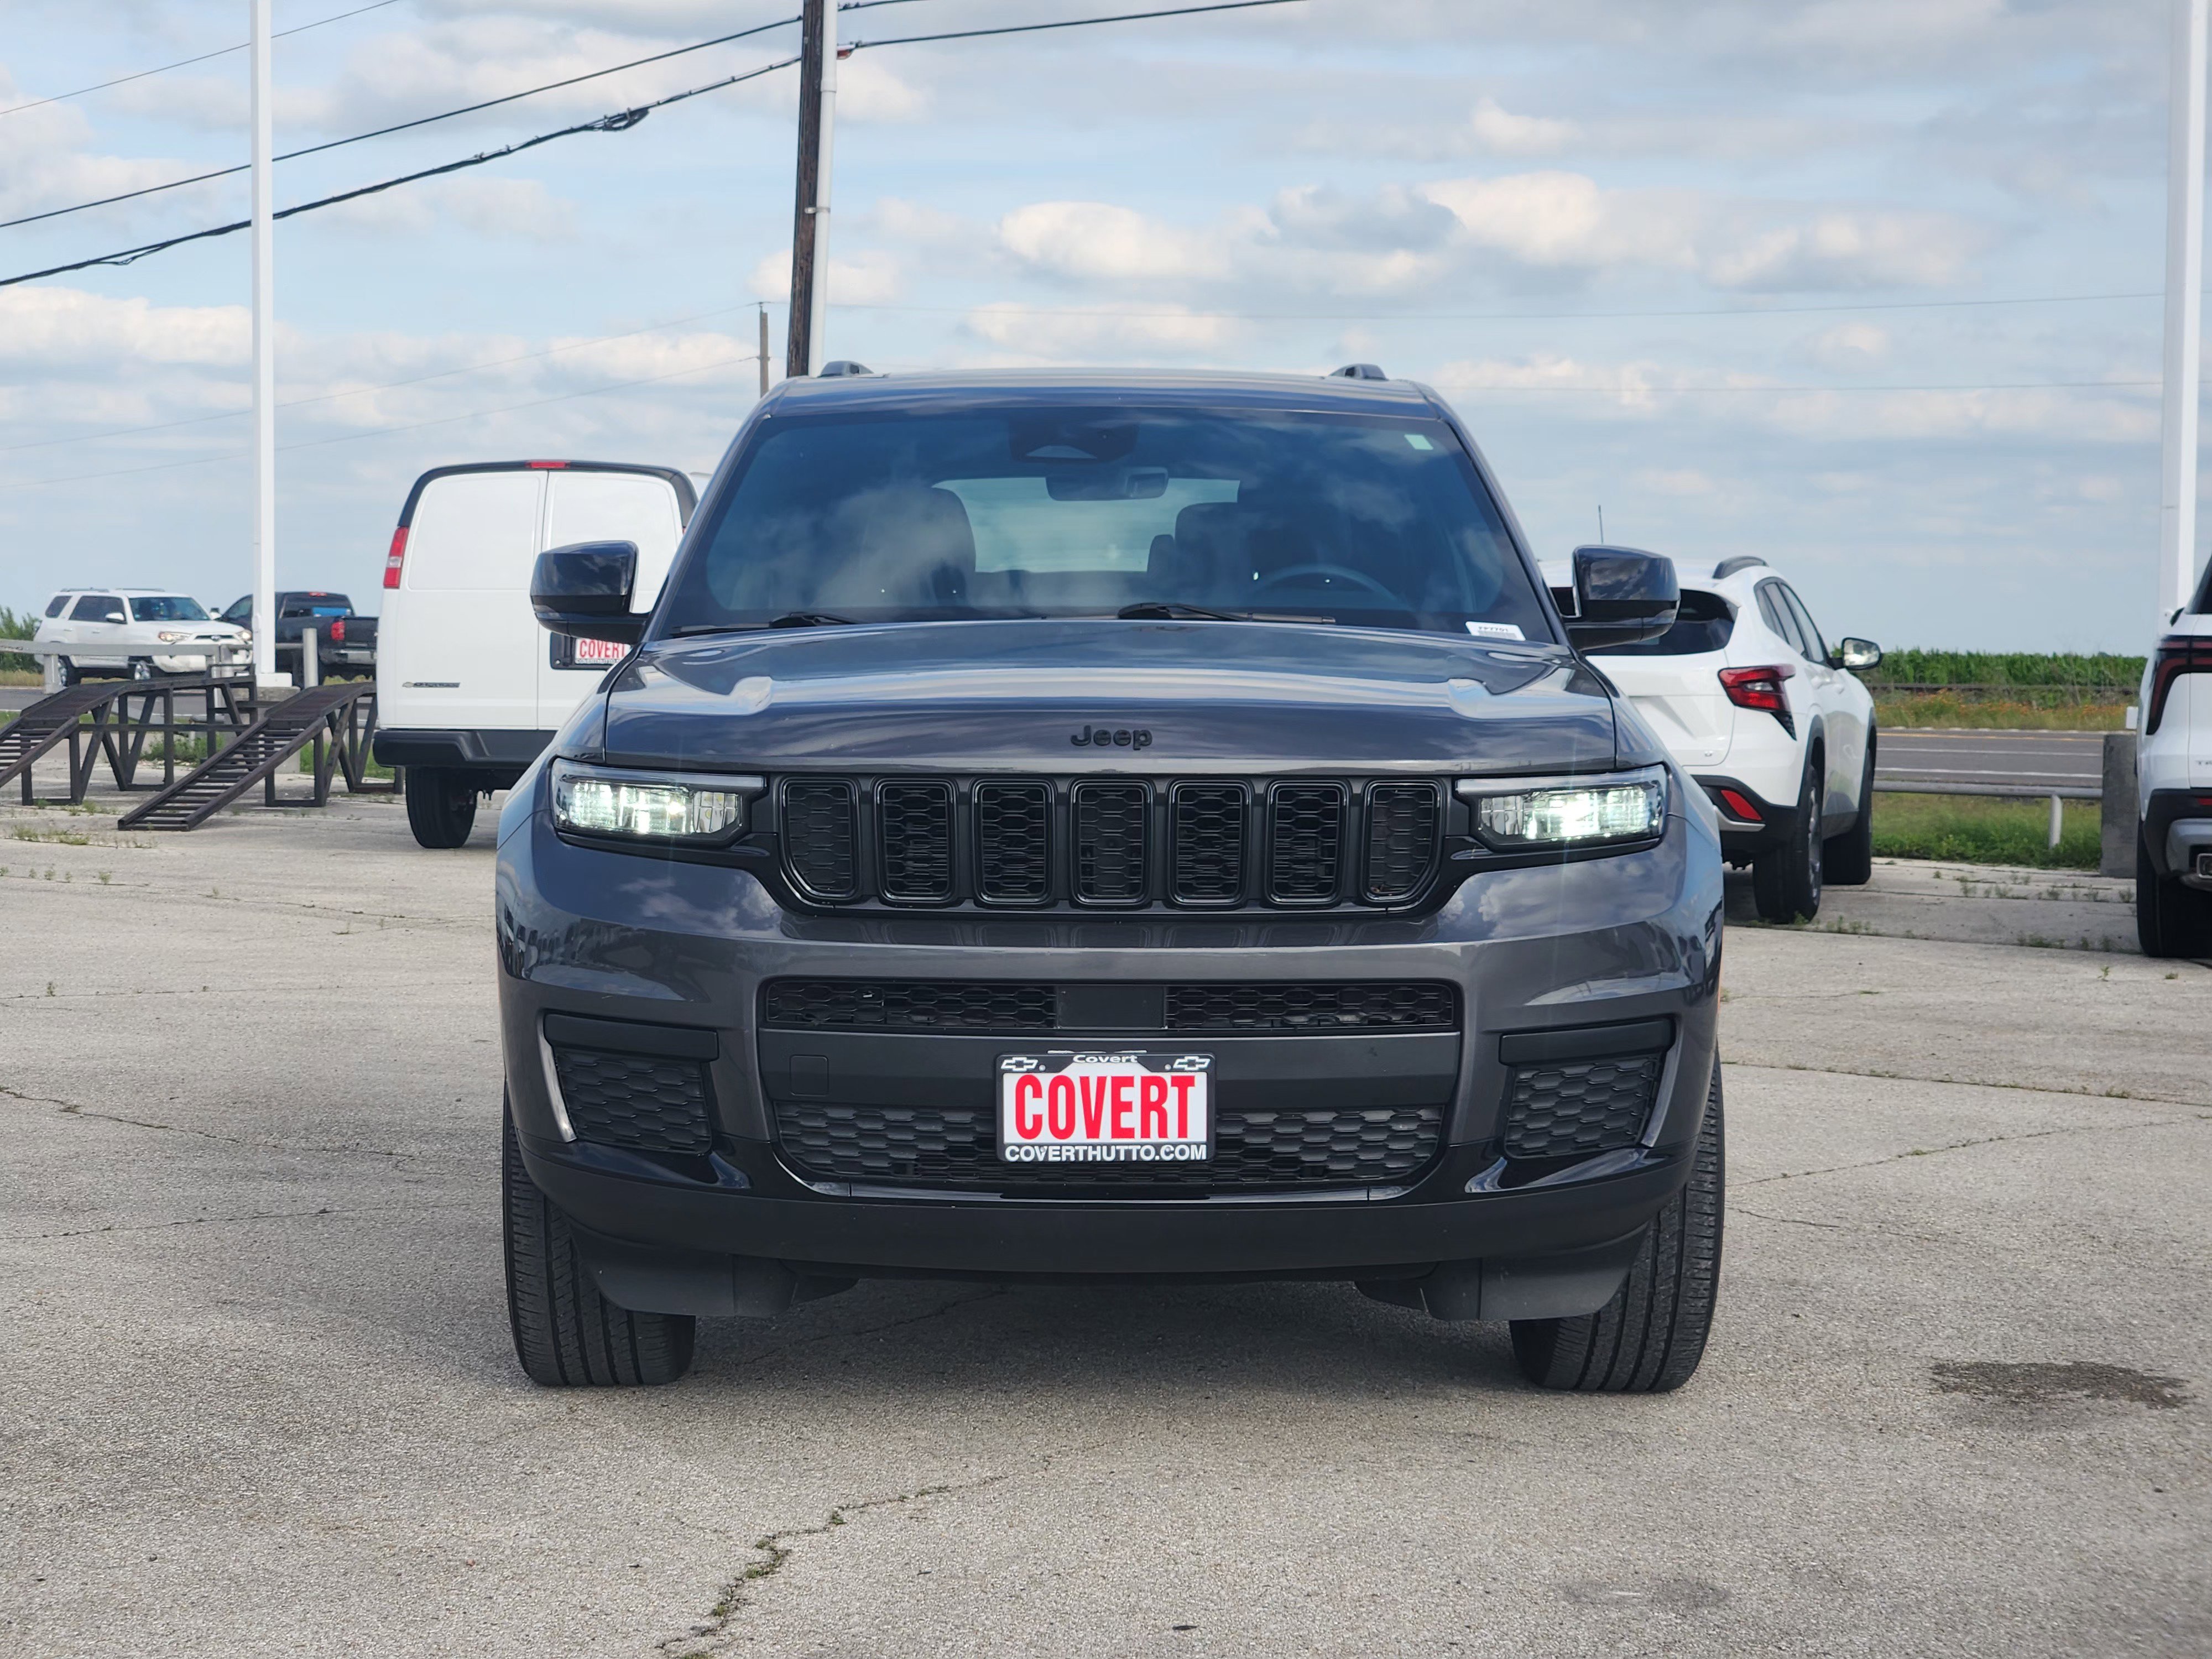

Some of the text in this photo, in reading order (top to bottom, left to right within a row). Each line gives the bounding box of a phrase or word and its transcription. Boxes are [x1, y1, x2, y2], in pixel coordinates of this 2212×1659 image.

[1071, 725, 1152, 750] Jeep
[1073, 1055, 1138, 1063] Covert
[1015, 1074, 1196, 1140] COVERT
[1005, 1144, 1207, 1162] COVERTHUTTO.COM
